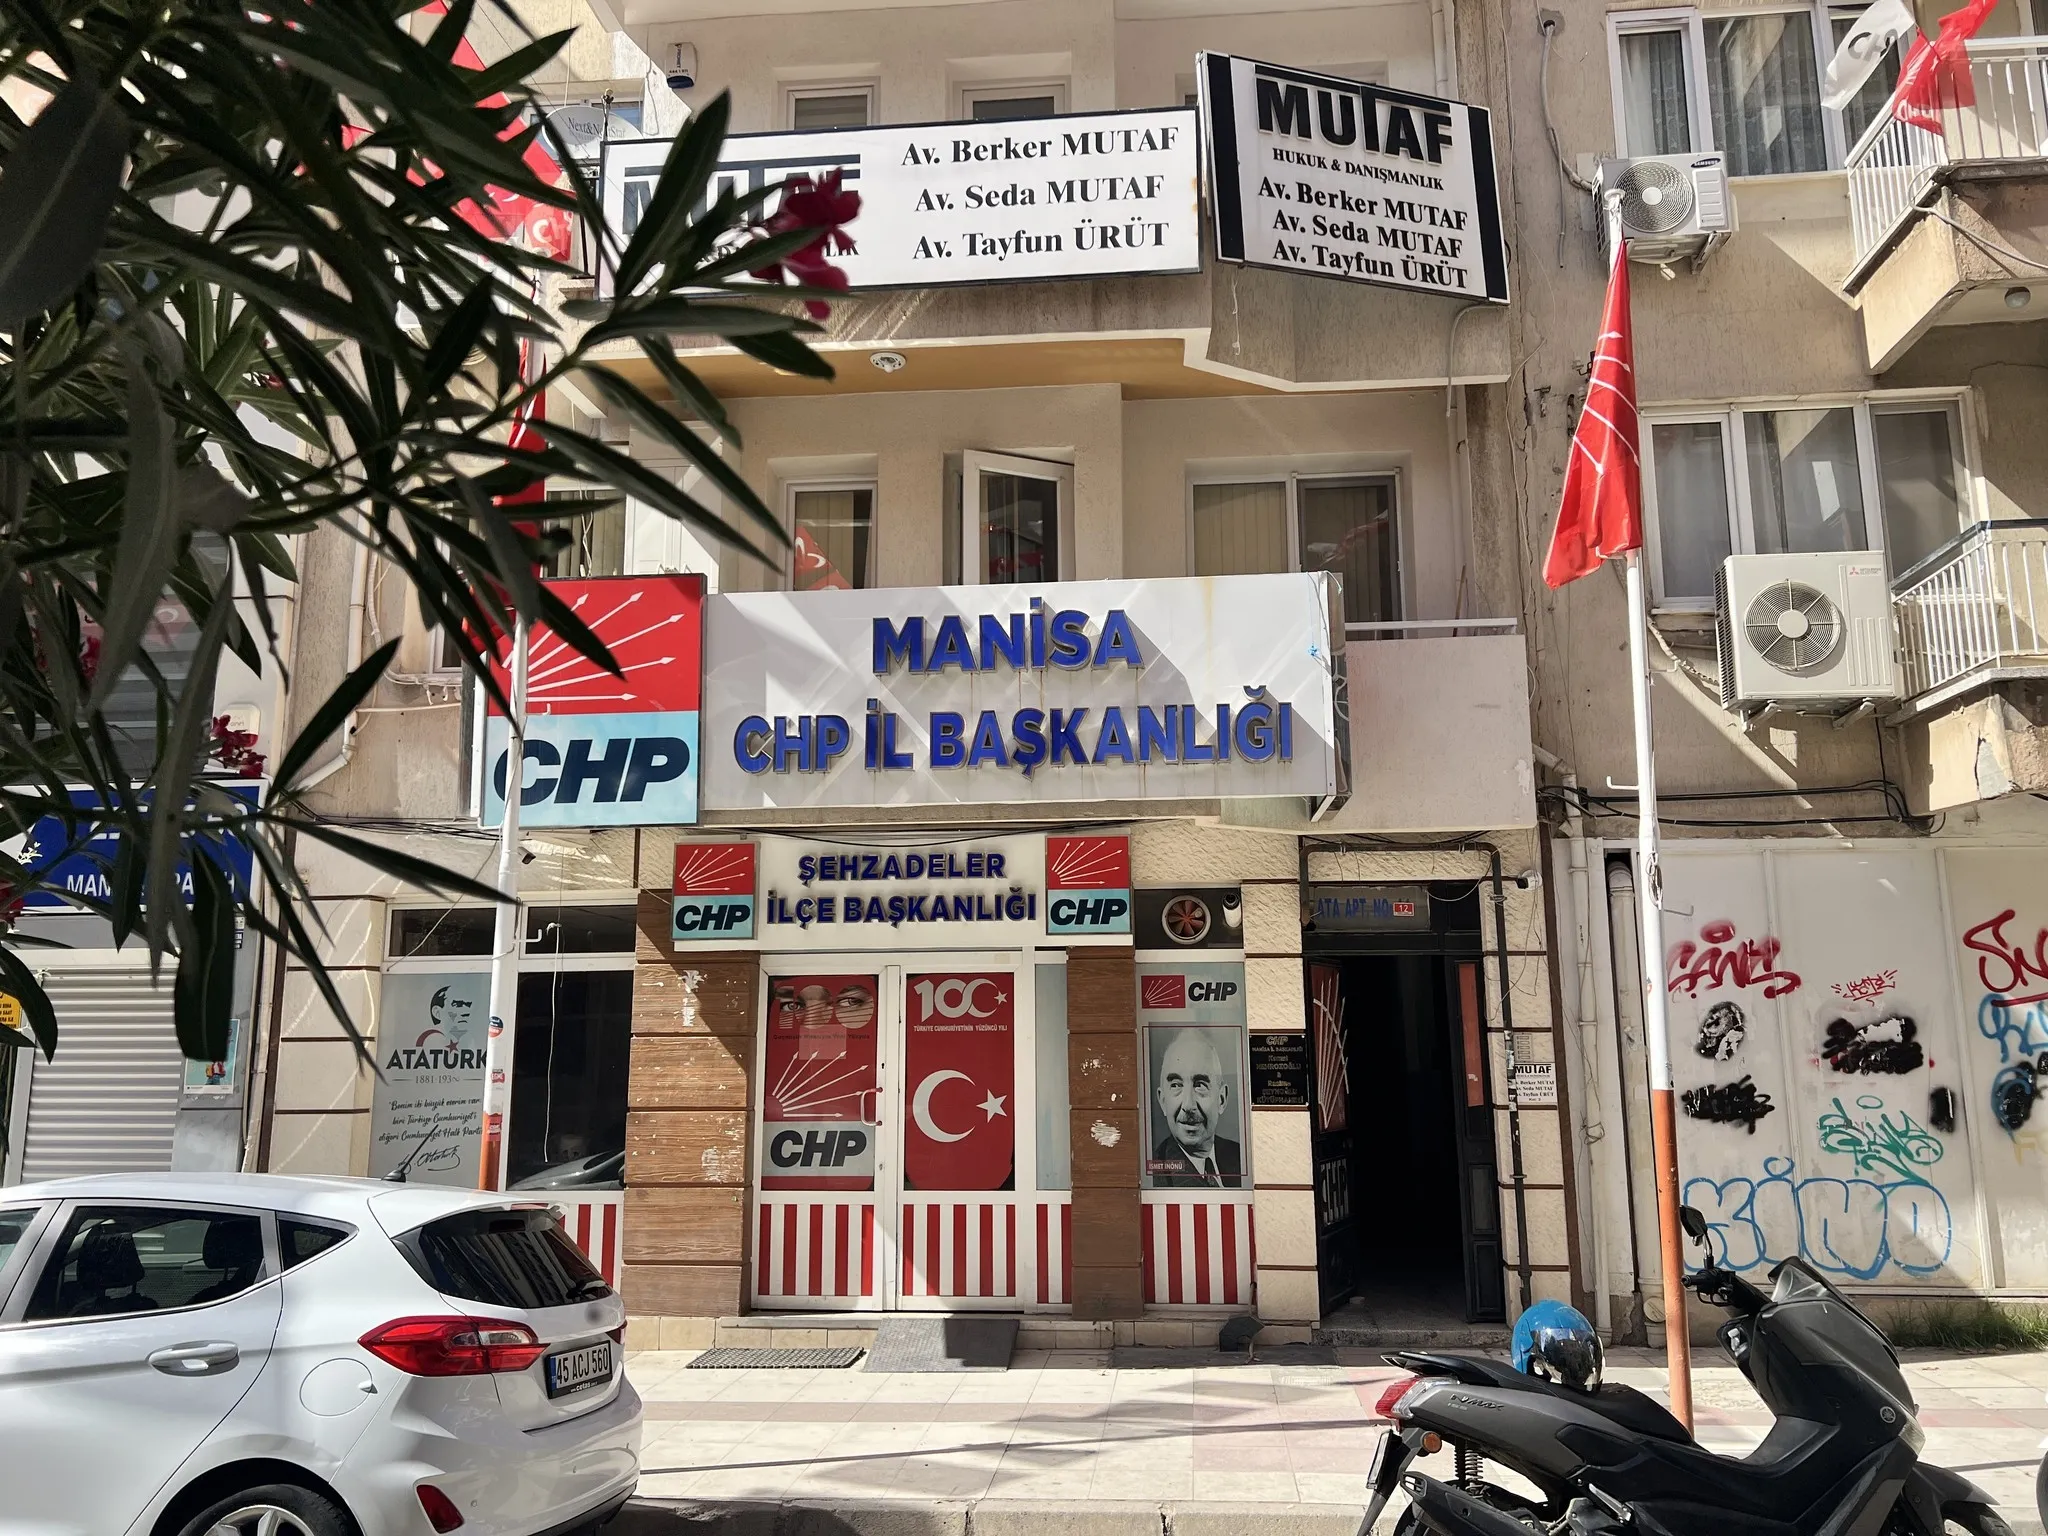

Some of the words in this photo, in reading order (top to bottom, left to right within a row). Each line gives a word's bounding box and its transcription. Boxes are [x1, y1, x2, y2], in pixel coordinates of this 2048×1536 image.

[568, 117, 626, 139] Next&NtStar
[1255, 64, 1453, 165] MUTAF
[902, 143, 940, 166] Av.
[951, 137, 1052, 163] Berker
[1061, 127, 1179, 157] MUTAF
[1272, 148, 1327, 170] HUKUK
[1331, 159, 1341, 172] &
[1345, 162, 1444, 191] DANIŞMANLIK
[915, 189, 954, 212] Av.
[965, 184, 1035, 210] Seda
[1047, 175, 1165, 204] MUTAF
[1258, 177, 1291, 200] Av.
[1296, 182, 1378, 216] Berker
[1383, 199, 1467, 231] MUTAF
[912, 236, 952, 259] Av.
[962, 230, 1063, 261] Tayfun
[1074, 217, 1170, 250] ÜRÜT
[1273, 210, 1306, 233] Av.
[1312, 215, 1369, 243] Seda
[1376, 226, 1462, 258] MUTAF
[1273, 240, 1307, 263] Av.
[1312, 245, 1395, 278] Tayfun
[1401, 255, 1468, 289] ÜRÜT
[872, 596, 1145, 676] MANİSA
[733, 713, 852, 775] CHP
[864, 697, 915, 773] İL
[929, 684, 1293, 782] BAŞKANLIĞI
[494, 737, 690, 806] CHP
[798, 852, 1007, 889] ŞEHZADELER
[674, 904, 751, 932] CHP
[766, 889, 837, 930] İLÇE
[842, 887, 1037, 929] BAŞKANLIĞI
[1049, 898, 1128, 927] CHP
[1317, 898, 1340, 918] ATA
[1188, 982, 1237, 1003] CHP
[1266, 1036, 1288, 1045] CHP
[1515, 1064, 1551, 1074] MUTAF
[770, 1130, 867, 1168] CHP
[557, 1357, 569, 1384] 45
[573, 1352, 589, 1380] ACJ
[592, 1347, 608, 1373] 560
